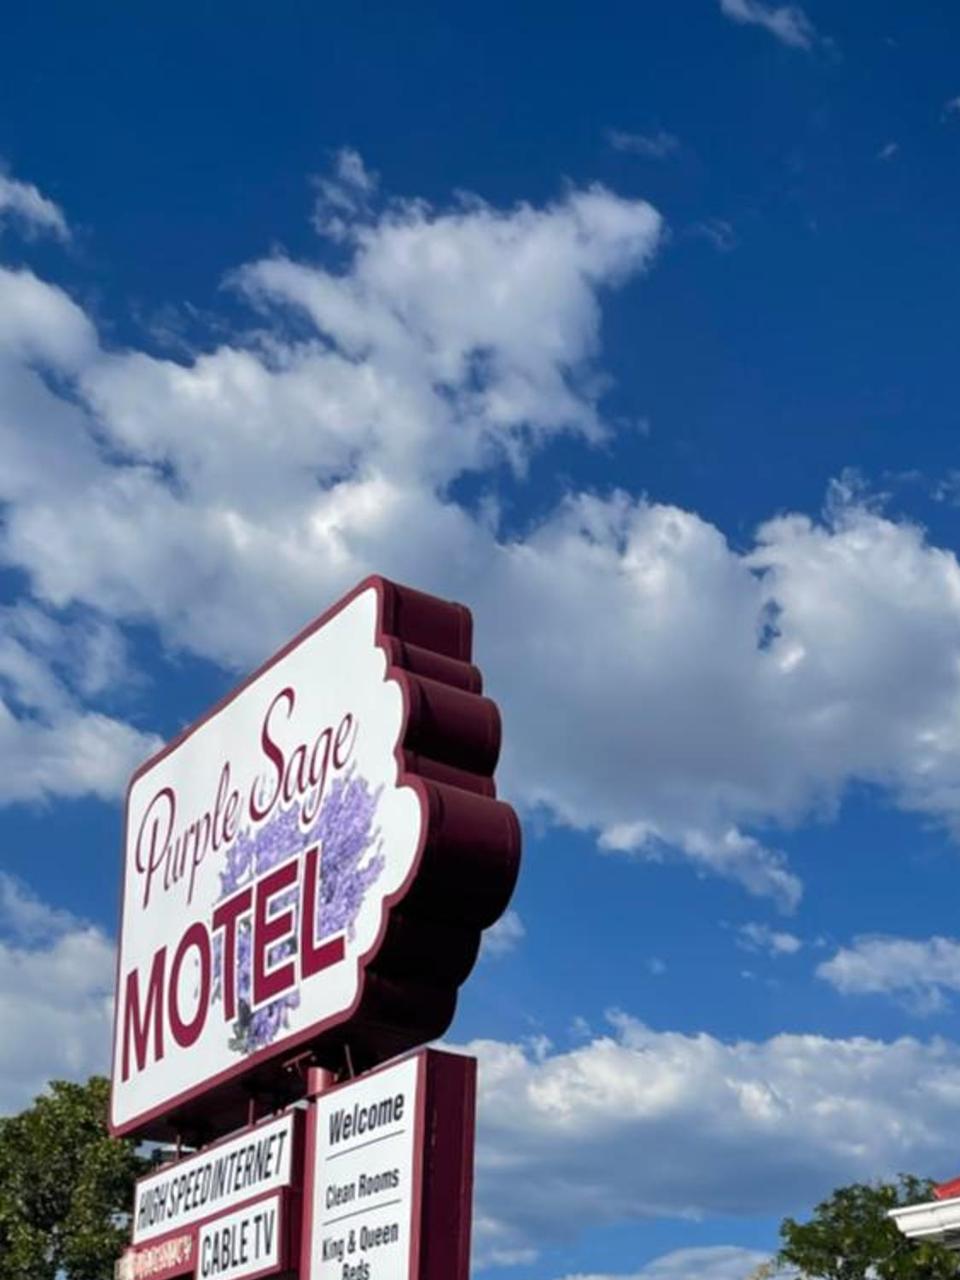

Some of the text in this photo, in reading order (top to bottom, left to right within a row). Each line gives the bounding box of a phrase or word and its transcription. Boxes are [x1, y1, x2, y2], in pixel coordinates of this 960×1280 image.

[135, 686, 354, 909] Purple Sage
[121, 846, 345, 1083] MOTEL
[329, 1093, 404, 1146] Welcome
[137, 1129, 288, 1231] HIGH SPEED INTERNET
[326, 1168, 400, 1210] Clean Rooms
[201, 1220, 249, 1278] CABLE
[253, 1209, 275, 1260] TV
[322, 1222, 399, 1263] King & Queen
